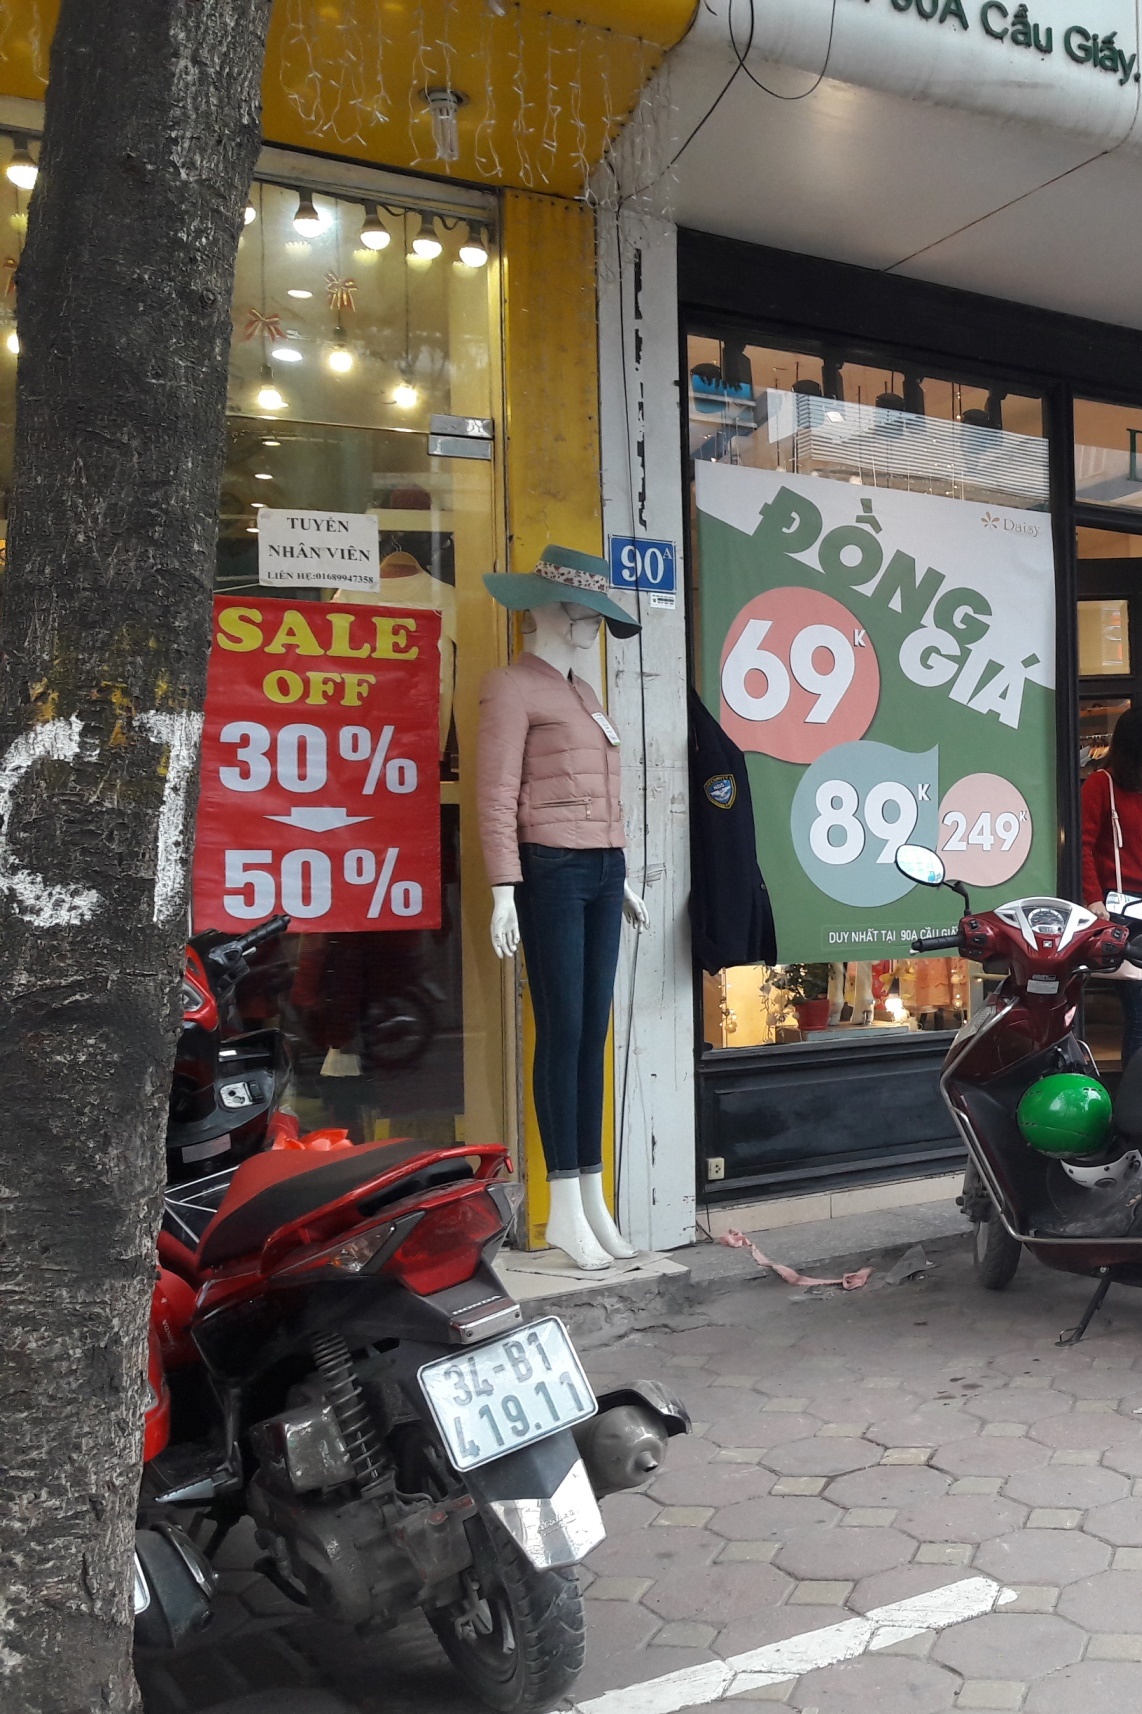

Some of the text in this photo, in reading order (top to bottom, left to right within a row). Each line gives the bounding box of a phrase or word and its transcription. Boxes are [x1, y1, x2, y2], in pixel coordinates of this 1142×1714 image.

[268, 543, 371, 562] NHÂN VIÊN
[1003, 518, 1041, 538] Daisy
[758, 485, 993, 645] ĐỒNG
[217, 606, 419, 661] SALE
[262, 670, 377, 706] OFF
[899, 627, 1041, 730] GIÁ
[829, 931, 849, 943] DUY
[881, 930, 896, 943] TẠI
[900, 929, 918, 941] 90A
[444, 1332, 552, 1406] 34-B1
[454, 1371, 585, 1459] 419.11
